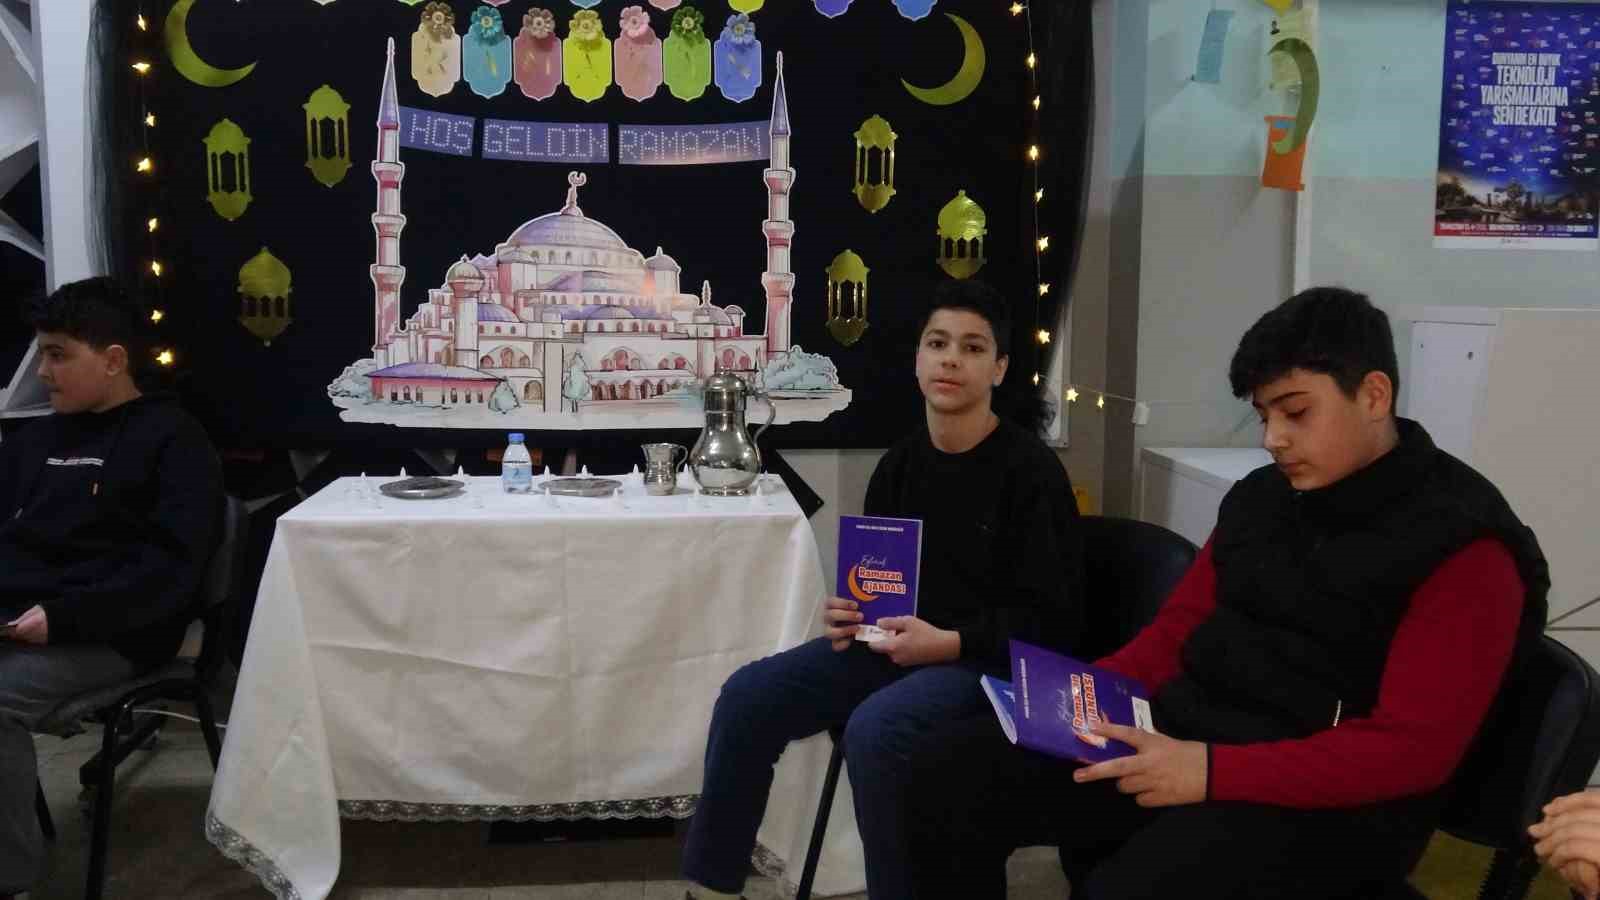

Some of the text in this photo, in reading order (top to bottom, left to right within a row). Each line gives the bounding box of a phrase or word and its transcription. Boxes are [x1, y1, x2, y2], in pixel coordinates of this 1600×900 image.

[409, 113, 761, 161] HOŞ GELDİN RAMAZAN
[858, 566, 903, 582] Ramazan
